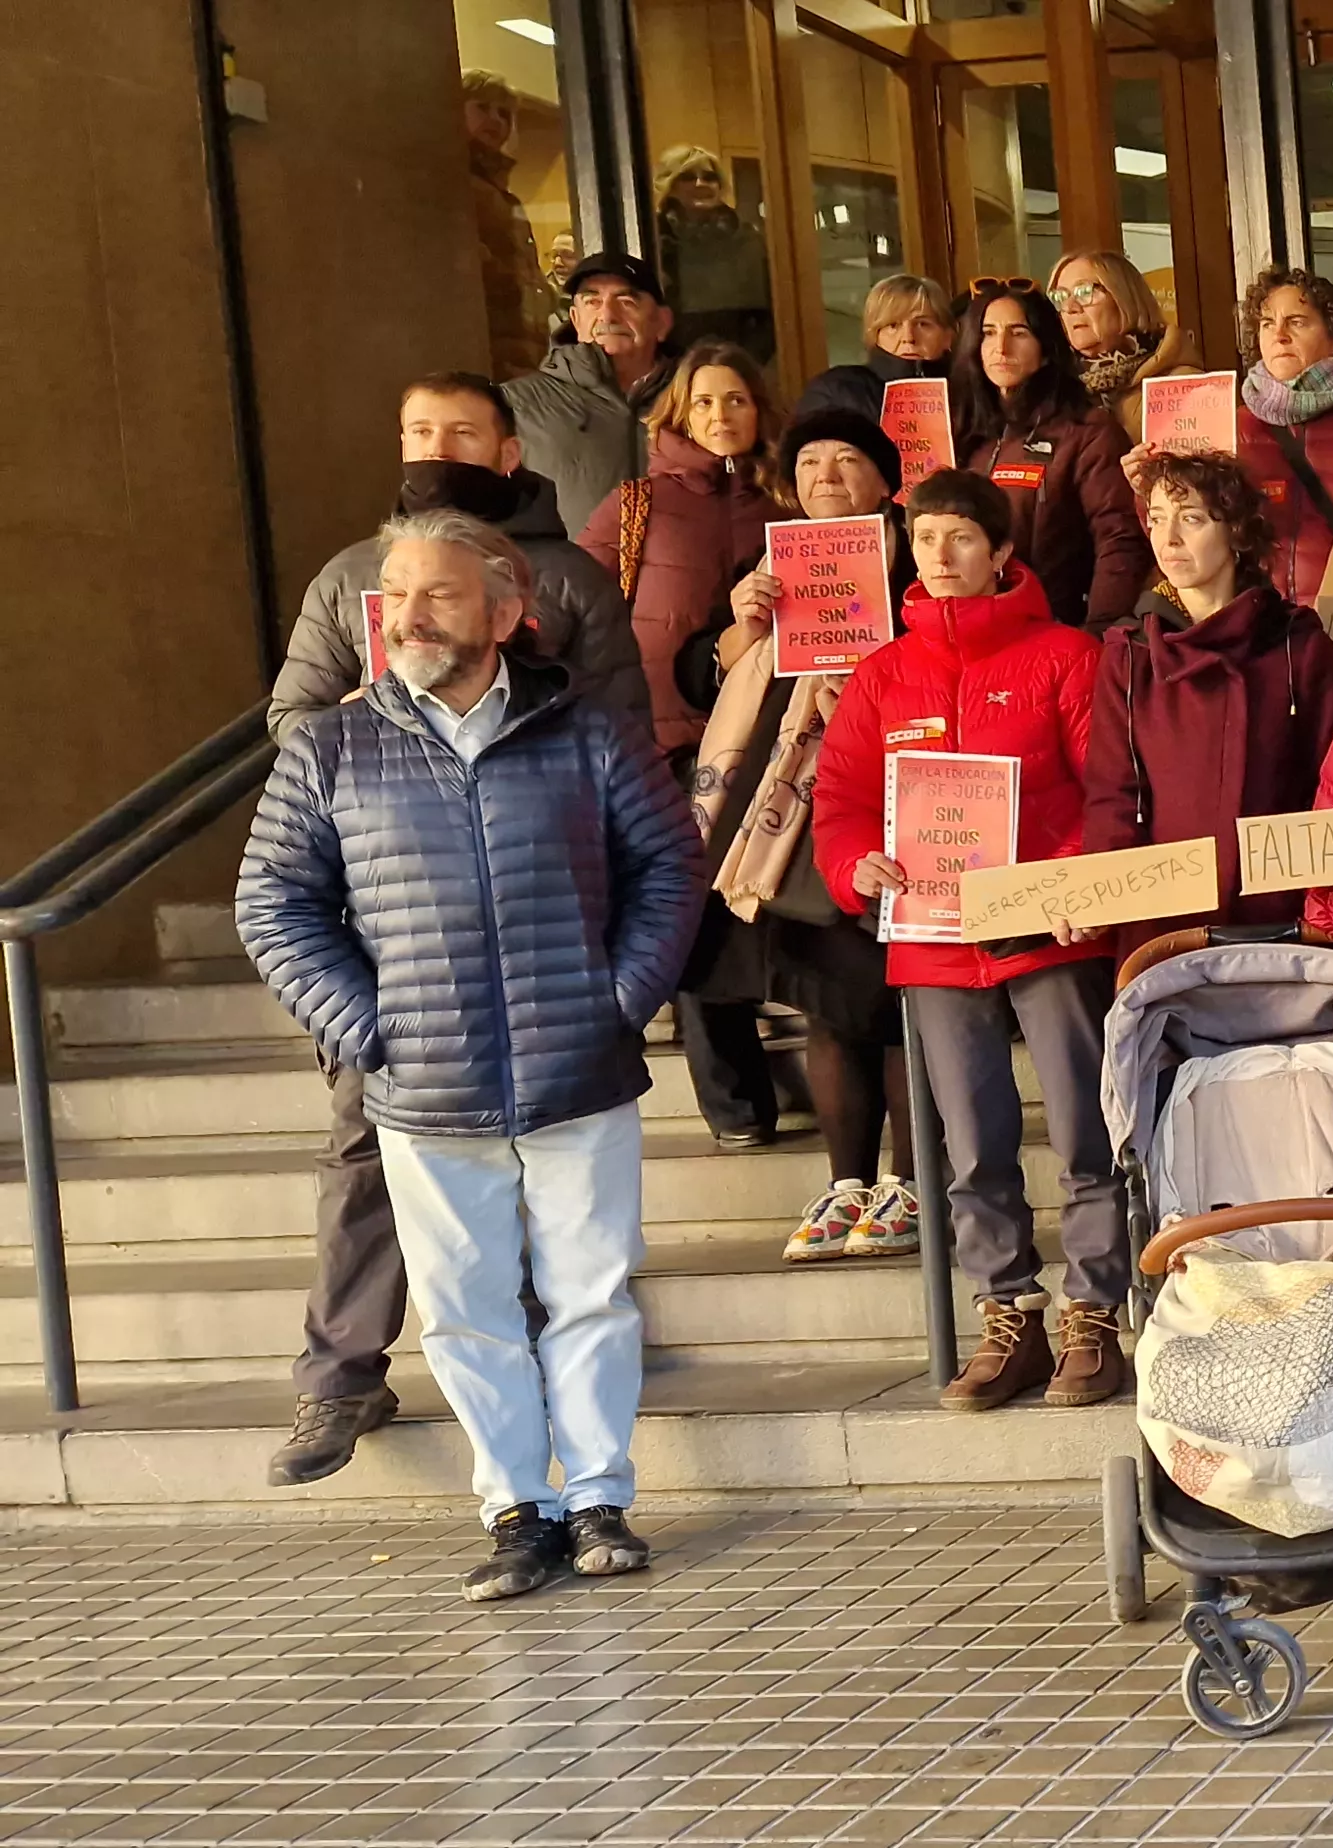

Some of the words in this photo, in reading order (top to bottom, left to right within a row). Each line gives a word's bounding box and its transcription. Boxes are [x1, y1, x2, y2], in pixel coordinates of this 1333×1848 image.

[1148, 387, 1165, 398] CON
[1168, 385, 1179, 396] LA
[1147, 400, 1163, 414] NO
[1167, 400, 1182, 412] SE
[898, 420, 918, 433] SIN
[1174, 417, 1197, 431] SIN
[1161, 436, 1210, 451] MEDIOS
[904, 462, 924, 475] SIN
[774, 531, 795, 543] CON
[800, 531, 813, 541] LA
[818, 524, 876, 540] EDUCACIÓN
[773, 547, 793, 560] NO
[800, 544, 820, 558] SE
[826, 539, 880, 556] JUEGA
[809, 562, 838, 577] SIN
[794, 582, 857, 600] MEDIOS
[818, 607, 847, 624] SIN
[788, 626, 879, 647] PERSONAL
[901, 766, 922, 777] CON
[926, 767, 941, 778] LA
[945, 767, 1005, 781] EDUCACIÓN
[900, 782, 919, 797] NO
[927, 783, 947, 797] SE
[953, 785, 1007, 800] JUEGA
[935, 806, 964, 823] SIN
[917, 829, 980, 846] MEDIOS
[936, 856, 966, 873] SIN
[905, 879, 960, 897] PERSO
[1041, 848, 1204, 925] RESPUESTAS
[965, 868, 1069, 931] QUEREMOS
